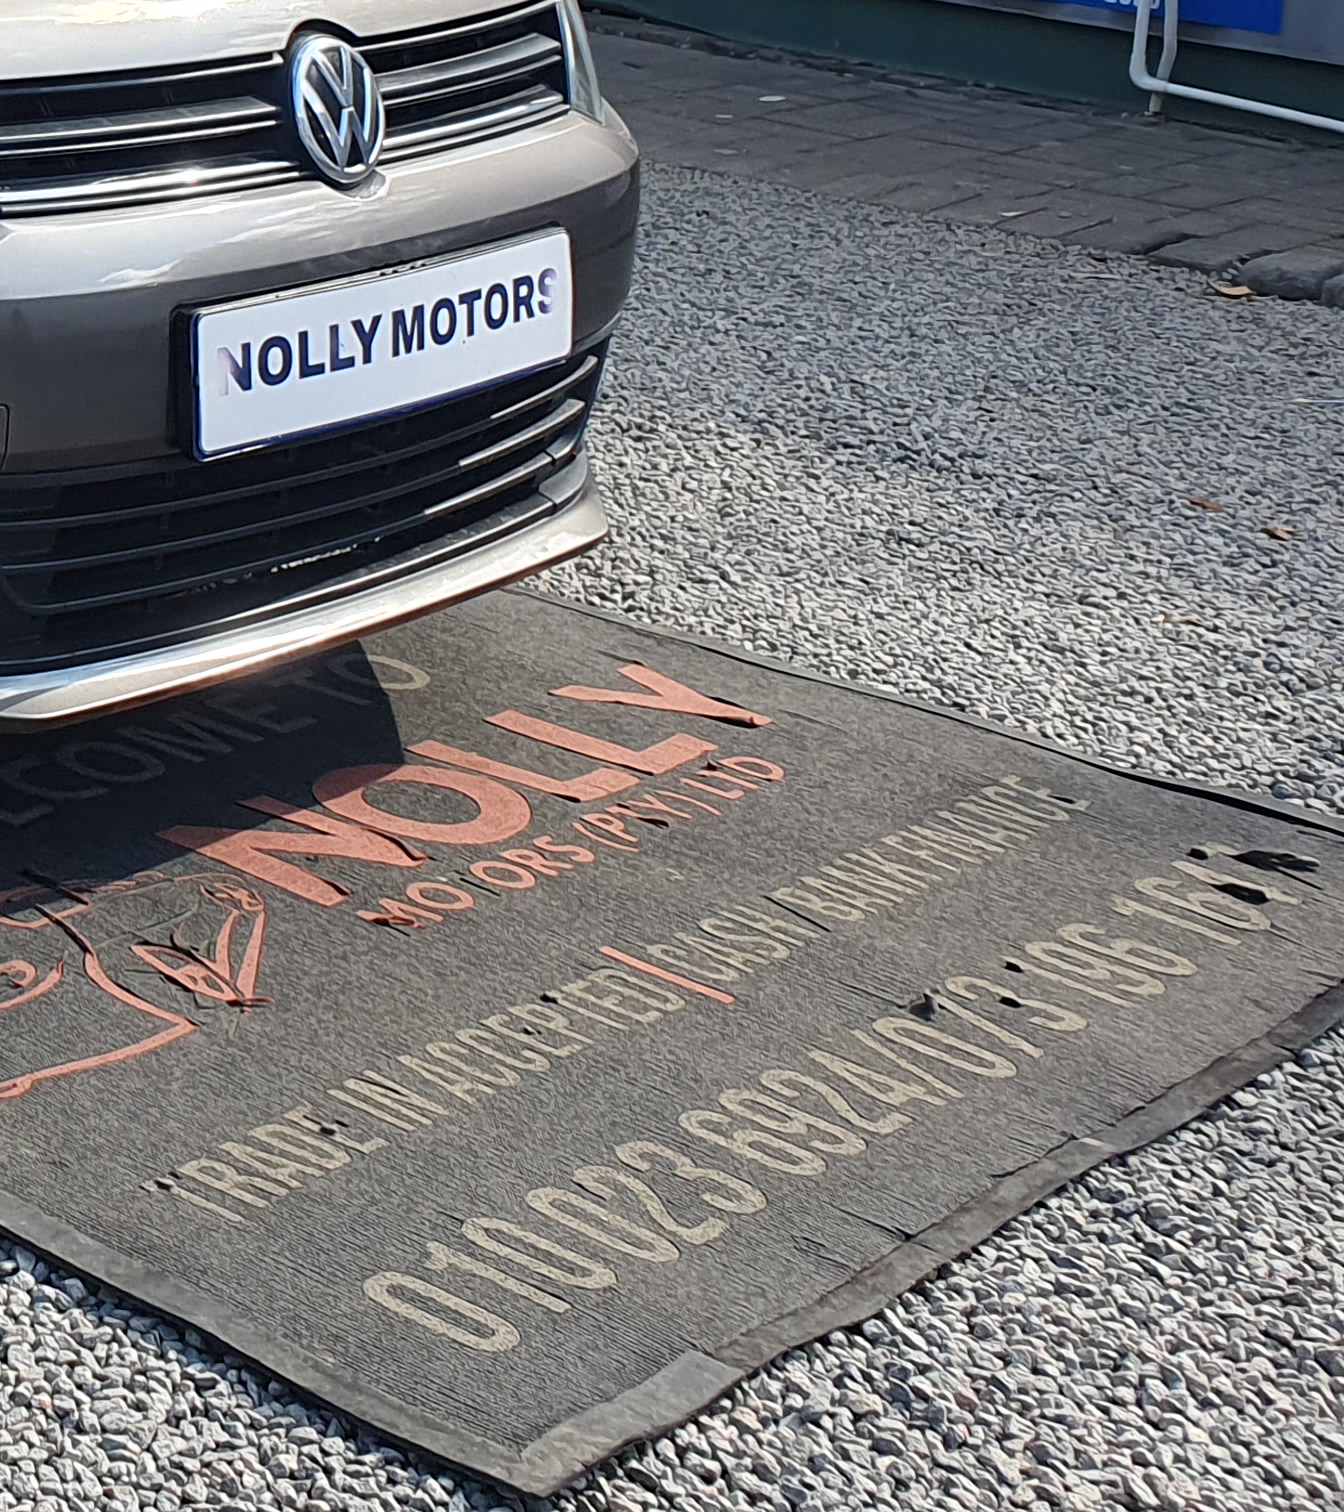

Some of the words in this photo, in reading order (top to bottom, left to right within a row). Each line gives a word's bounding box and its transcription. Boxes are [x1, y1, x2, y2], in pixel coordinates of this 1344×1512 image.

[216, 315, 382, 397] NOLLY
[390, 267, 560, 358] MOTORS
[269, 651, 431, 708] TO
[157, 663, 773, 908] NOLLY
[355, 834, 596, 929] MOORS
[140, 1103, 391, 1223] TRADE
[326, 1069, 452, 1132] IN
[399, 966, 688, 1105] ACCEPTED
[881, 774, 1091, 873] FINANCE
[363, 1216, 619, 1354] 010
[525, 1140, 769, 1264] 023
[1001, 921, 1199, 1008] 196
